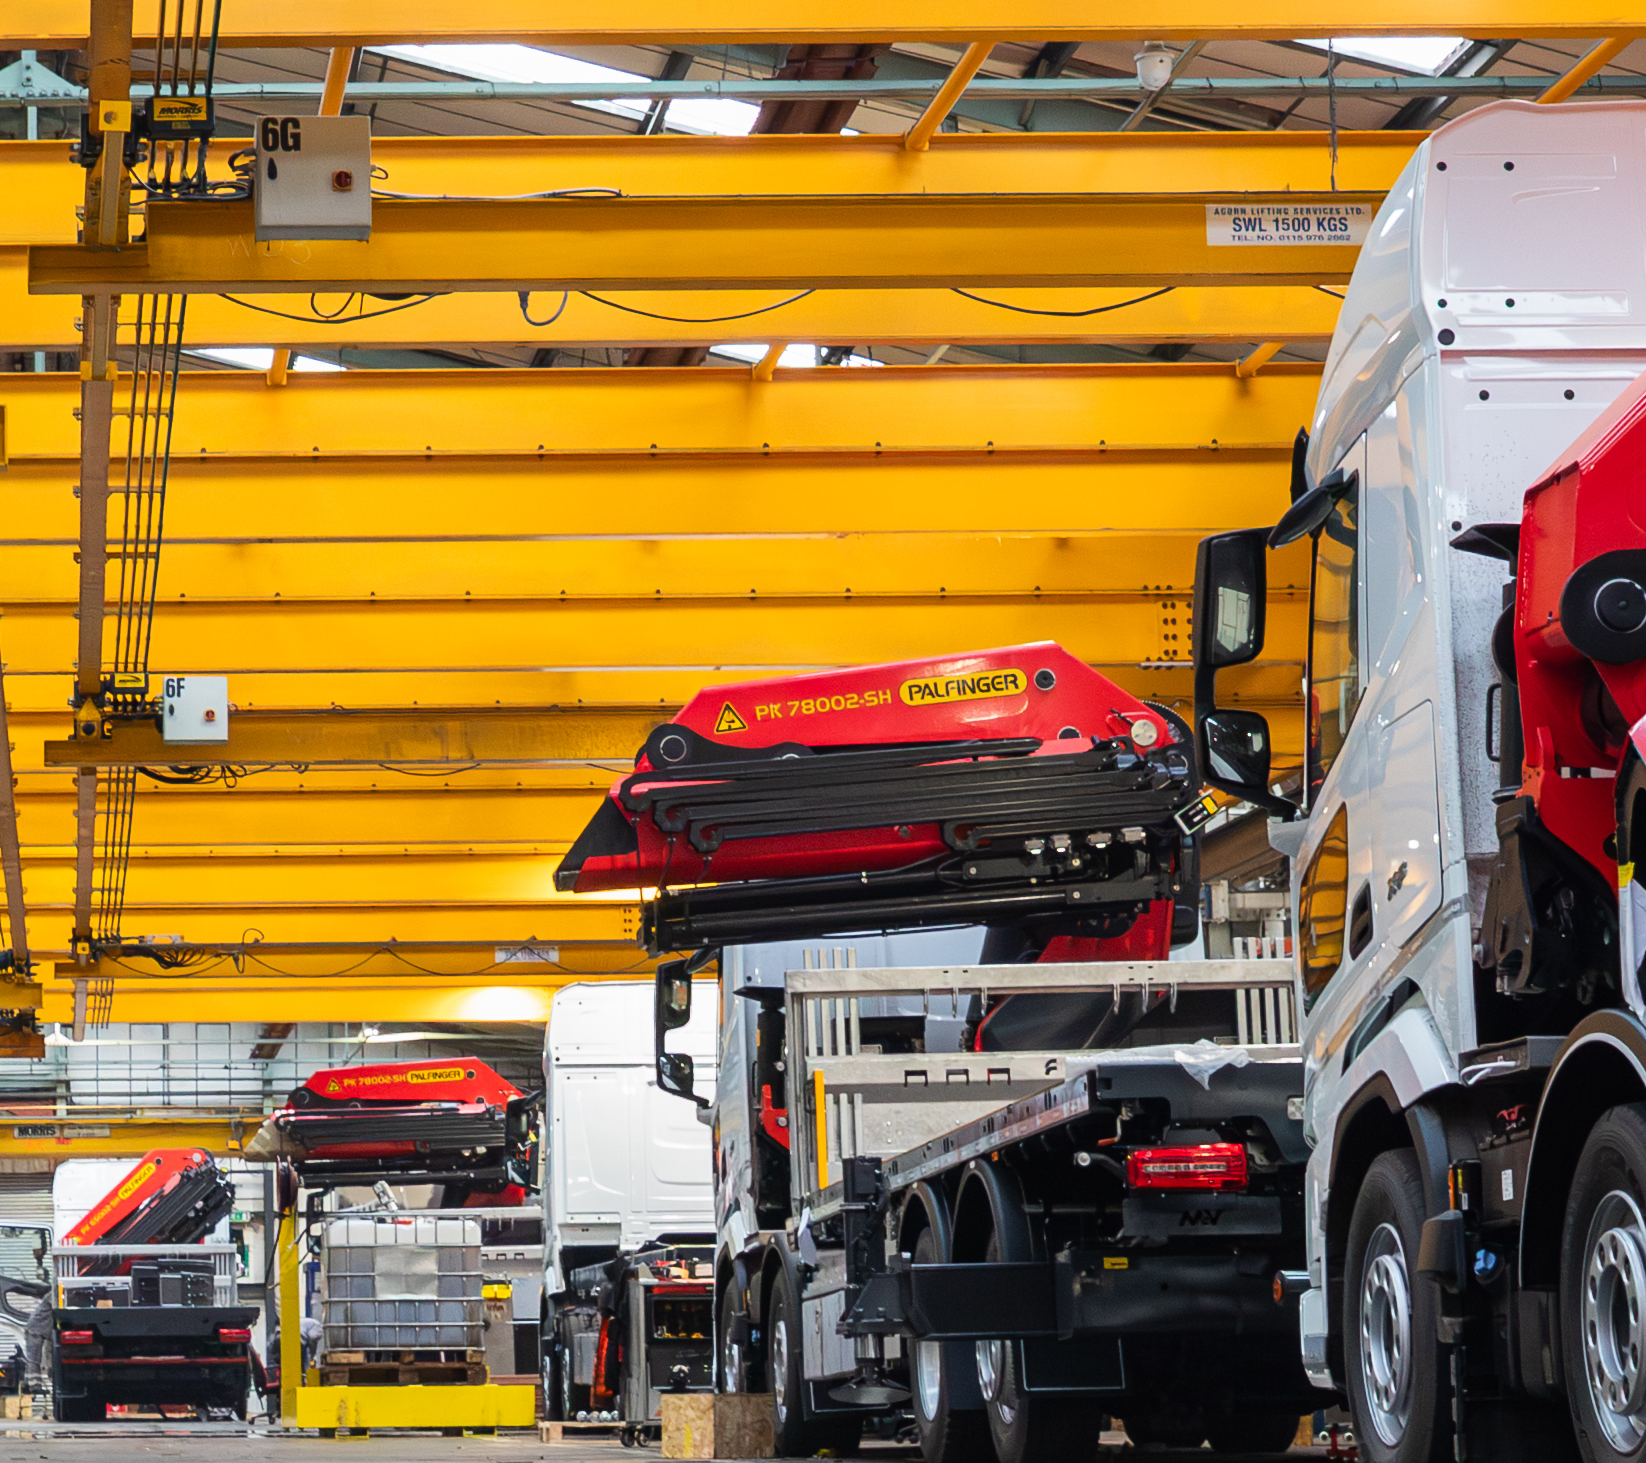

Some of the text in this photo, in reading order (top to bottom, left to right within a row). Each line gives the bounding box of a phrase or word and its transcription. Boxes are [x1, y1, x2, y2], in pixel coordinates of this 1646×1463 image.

[261, 117, 301, 152] 6G
[1214, 207, 1365, 215] ACORN LIFTING SERVICES LTD.
[1232, 217, 1349, 232] SWL 1500 KGS
[166, 678, 185, 698] 6F
[755, 703, 782, 721] PK
[908, 673, 1019, 701] PALFINGER
[410, 1070, 461, 1081] PALFINGER
[17, 1125, 56, 1137] MORRIS
